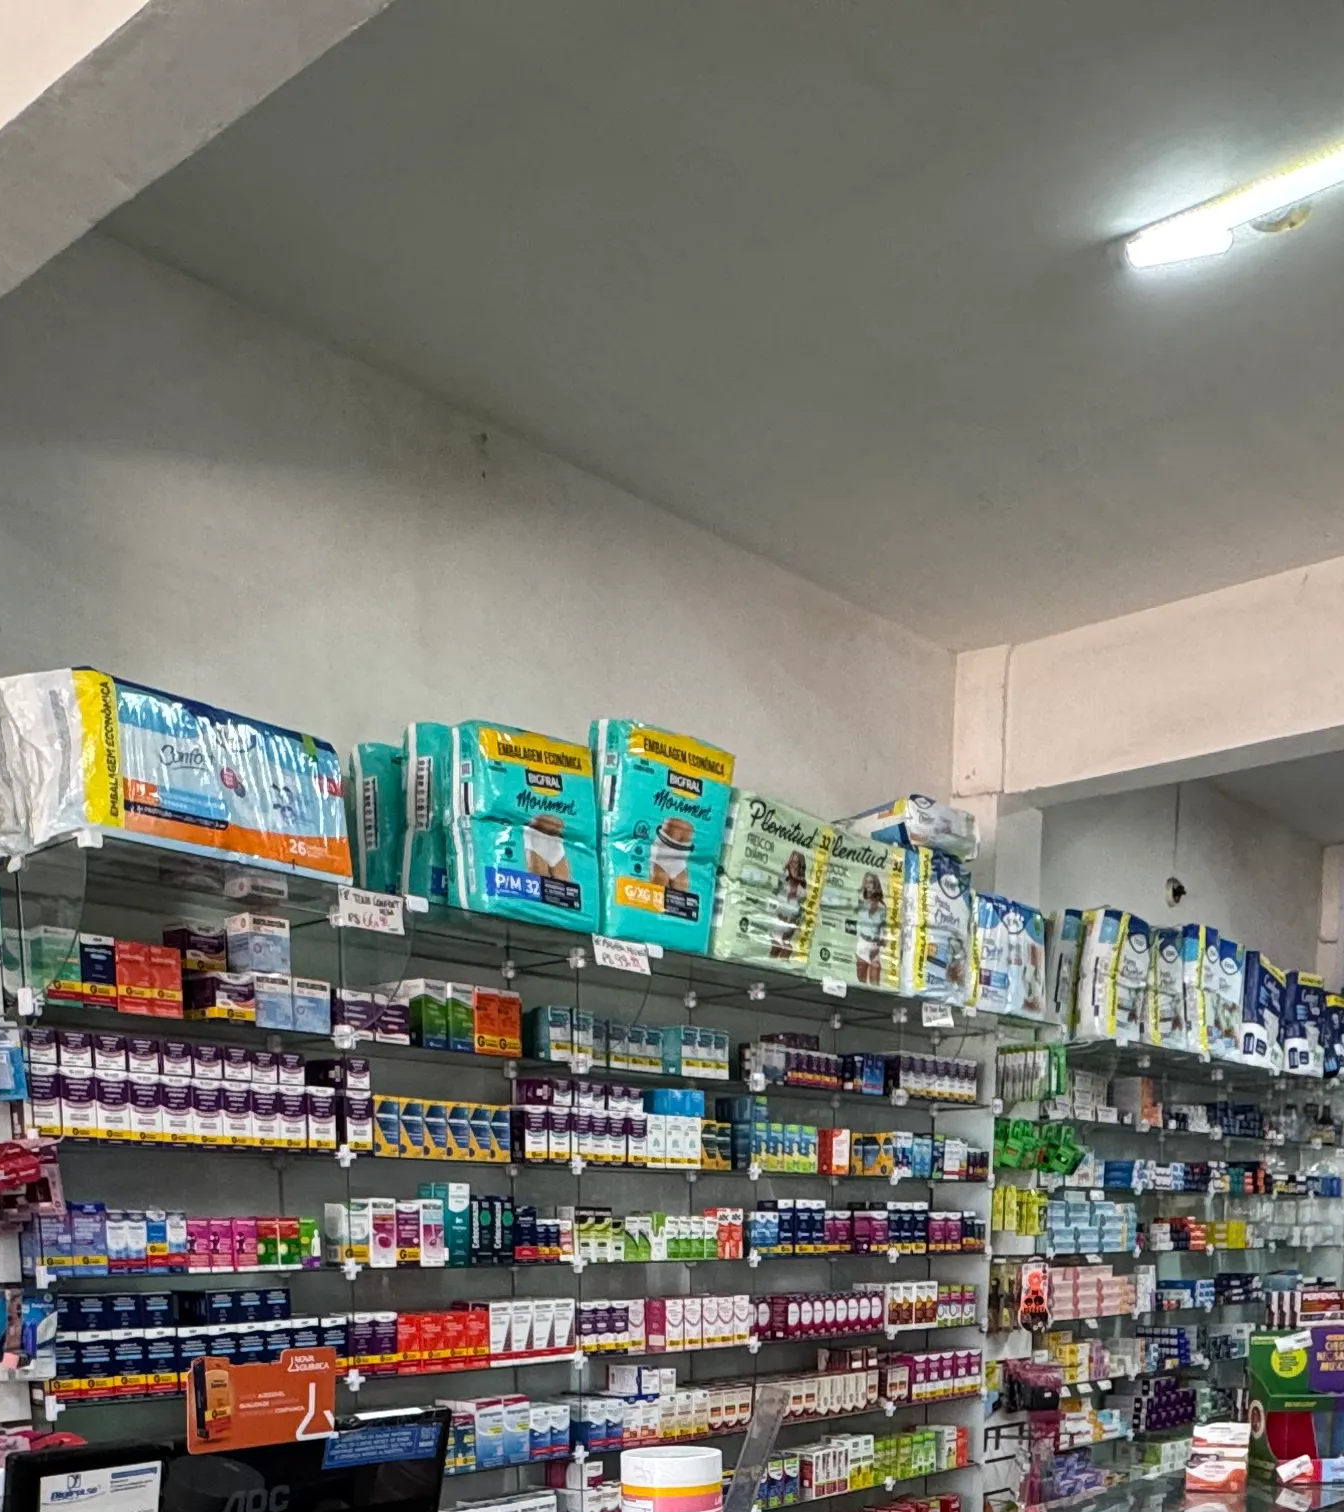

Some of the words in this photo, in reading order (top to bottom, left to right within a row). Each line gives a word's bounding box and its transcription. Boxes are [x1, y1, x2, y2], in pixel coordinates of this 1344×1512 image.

[99, 681, 116, 748] ECONÔMICA
[498, 740, 544, 764] EMBALAGEM
[544, 747, 583, 773] ECONÔMICA
[644, 738, 687, 760] EMBALAGEM
[687, 749, 724, 777] ECONÔMICA
[106, 750, 120, 818] EMBALAGEM
[528, 772, 562, 790] BIGFRAL
[668, 772, 701, 794] BIGFRAL
[749, 800, 819, 850] Plenitud
[288, 839, 306, 856] 26
[832, 834, 888, 871] lenitud
[496, 873, 522, 893] P/M
[525, 876, 541, 897] 32
[624, 883, 652, 902] G/XG
